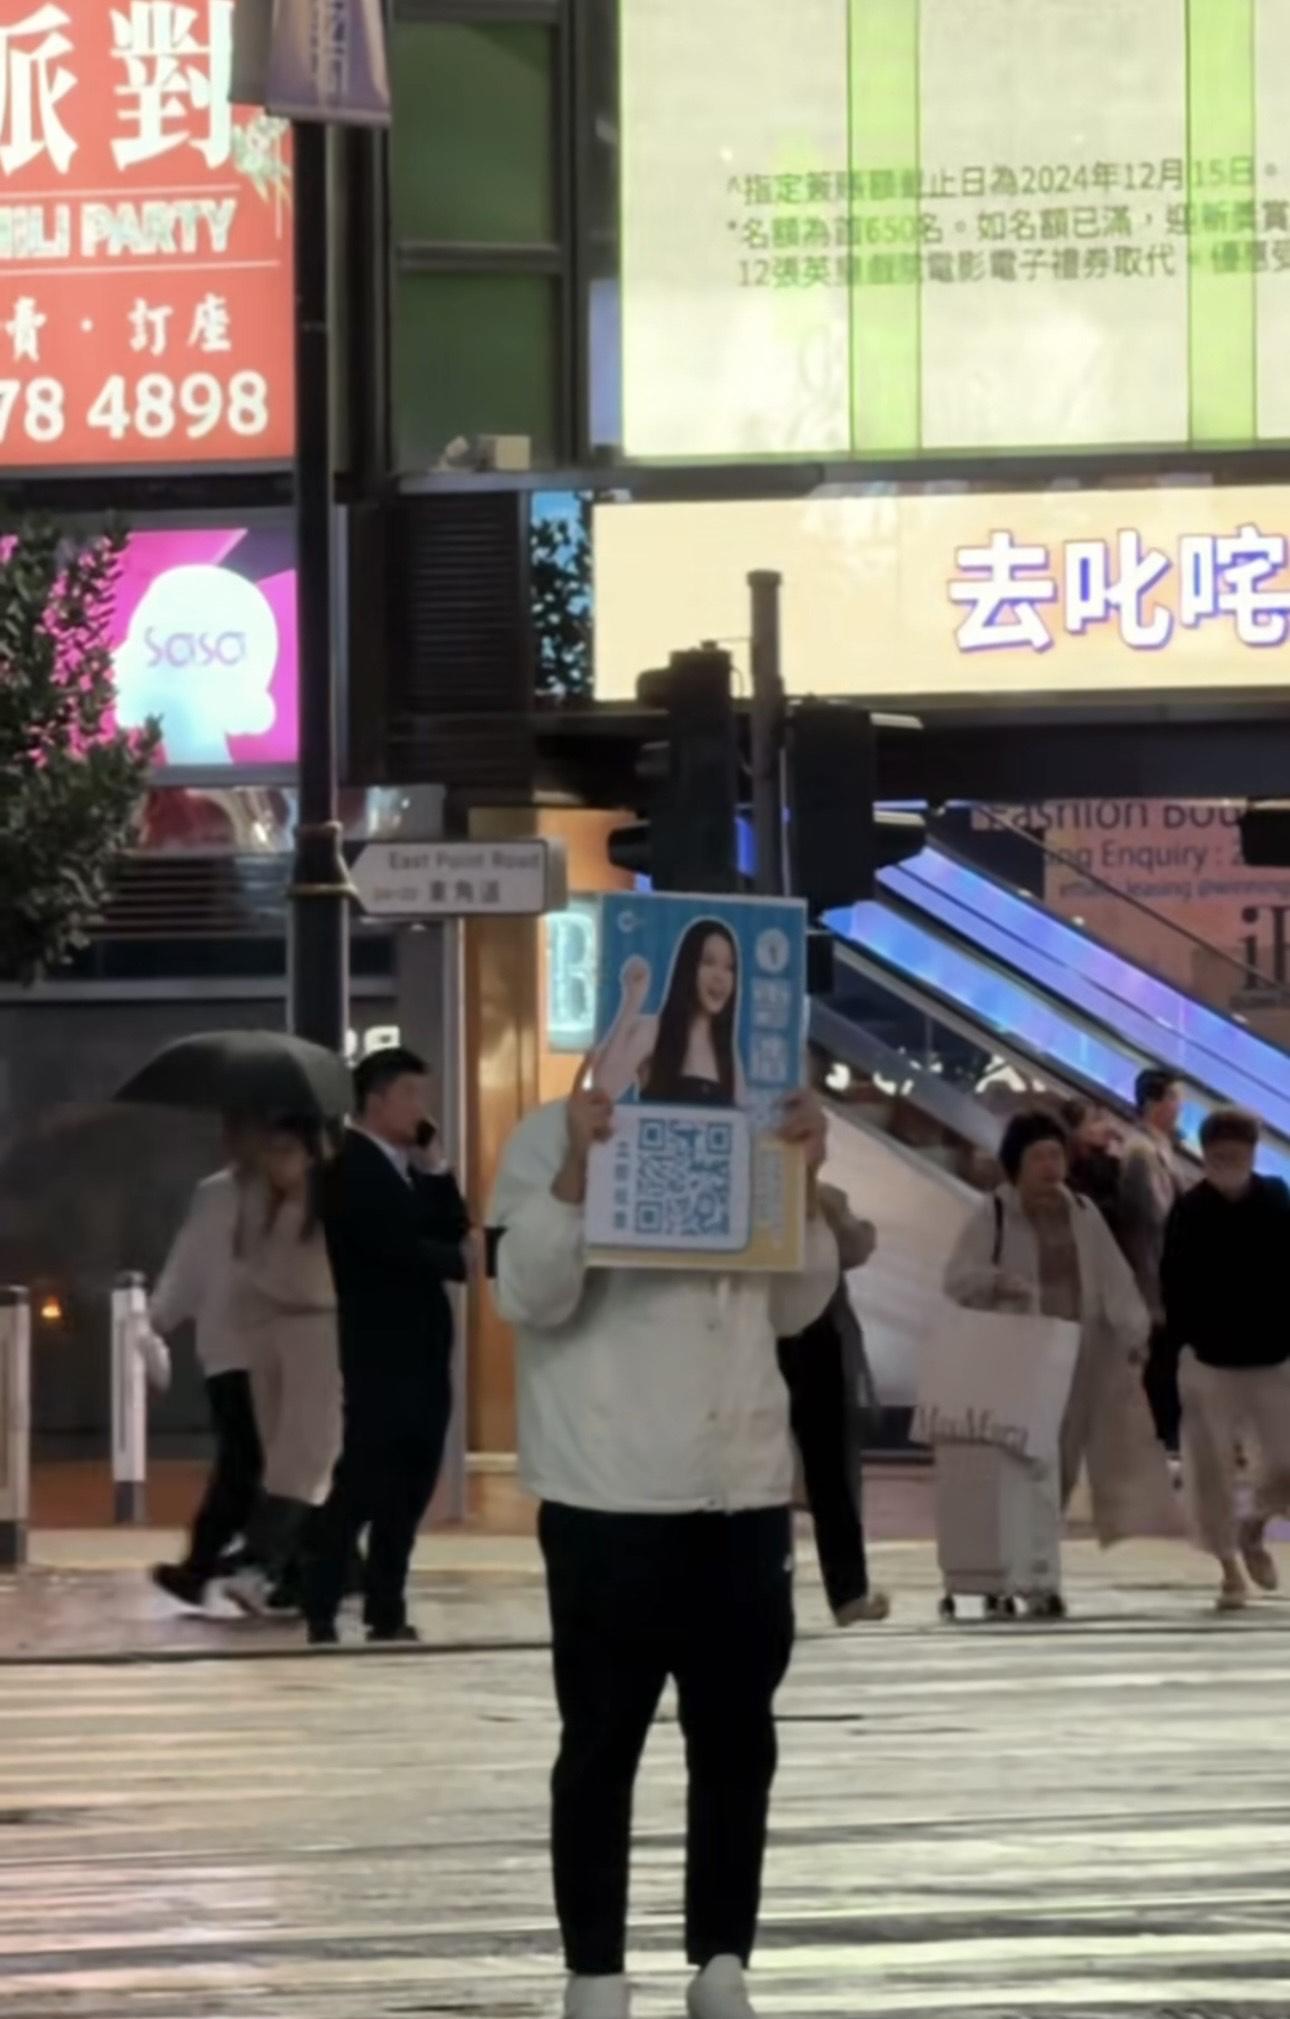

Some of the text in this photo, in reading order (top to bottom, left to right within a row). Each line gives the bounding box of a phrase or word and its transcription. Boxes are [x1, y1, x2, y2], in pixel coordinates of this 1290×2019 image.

[0, 1, 236, 175] 派對
[0, 198, 238, 259] ILI PARTY
[86, 369, 268, 439] 4898
[947, 522, 1290, 653] 去叱咤
[985, 799, 1150, 830] ashion
[388, 851, 541, 870] East Point Road
[1102, 840, 1207, 874] Enquiry
